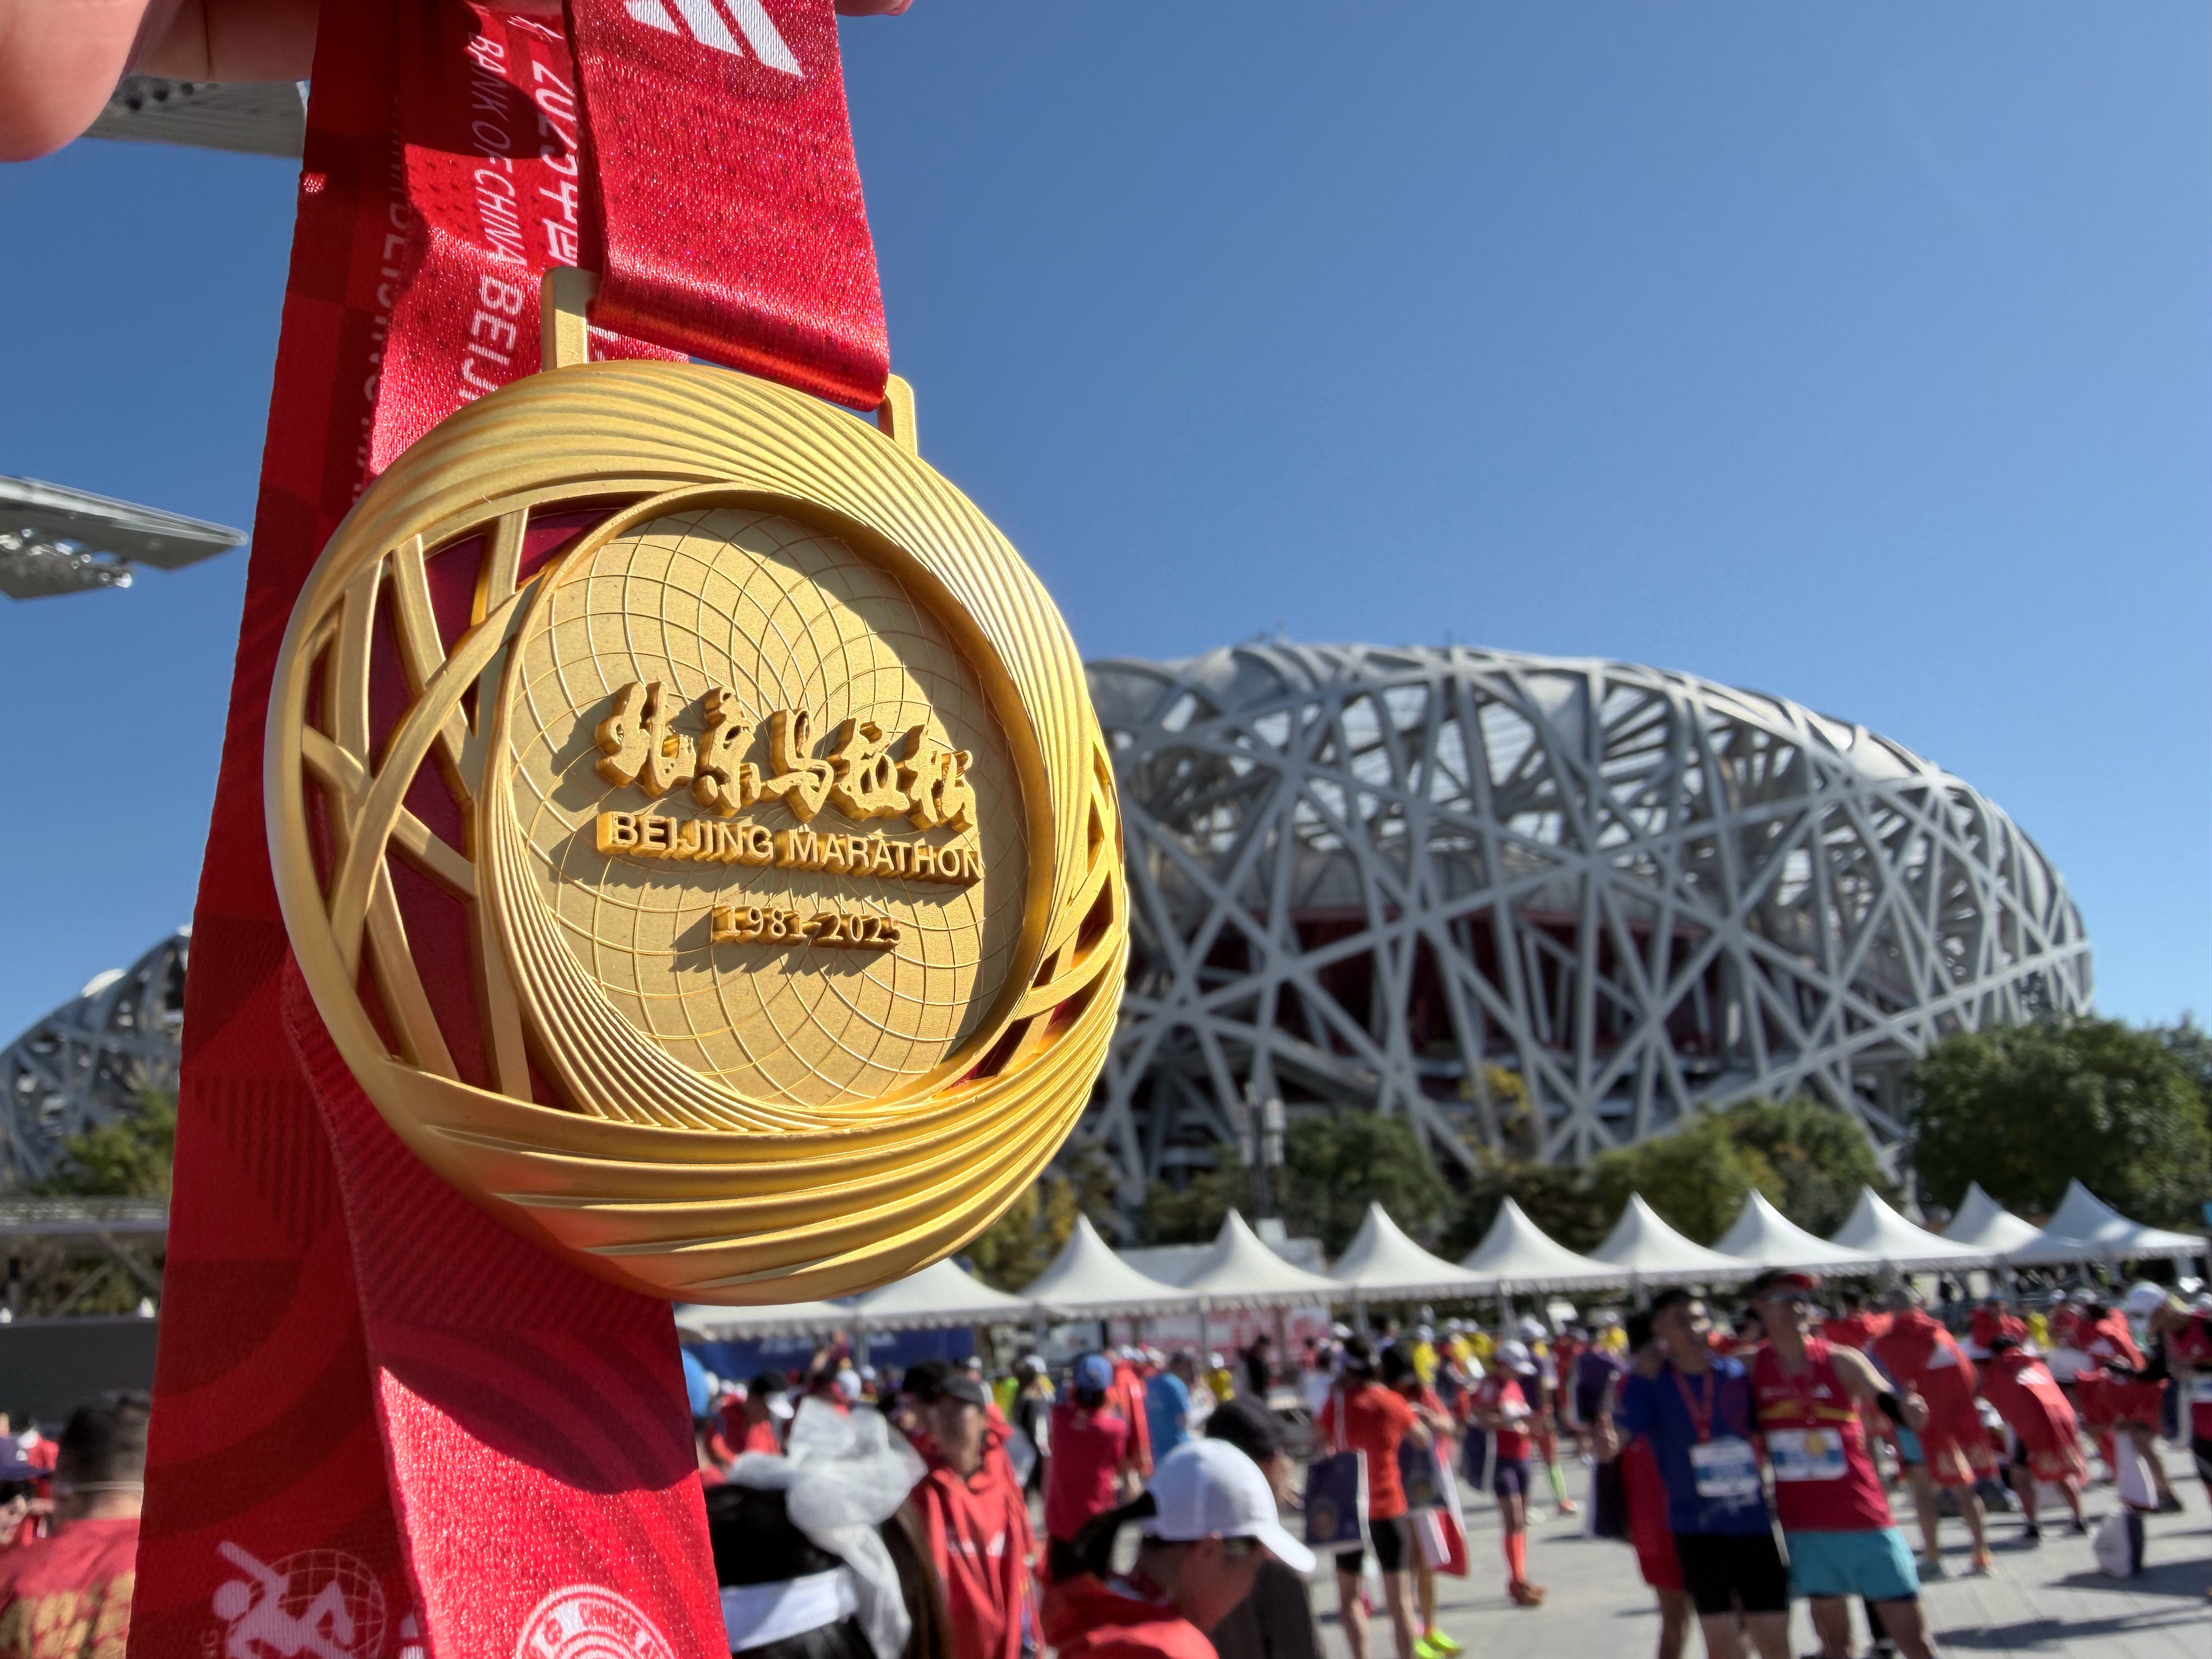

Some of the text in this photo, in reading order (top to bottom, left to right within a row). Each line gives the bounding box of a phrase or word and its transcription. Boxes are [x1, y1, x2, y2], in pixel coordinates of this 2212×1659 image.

[467, 32, 510, 120] BANK
[471, 120, 513, 173] OF
[475, 168, 527, 267] CHINA
[599, 812, 986, 883] BEIJING MARATHON
